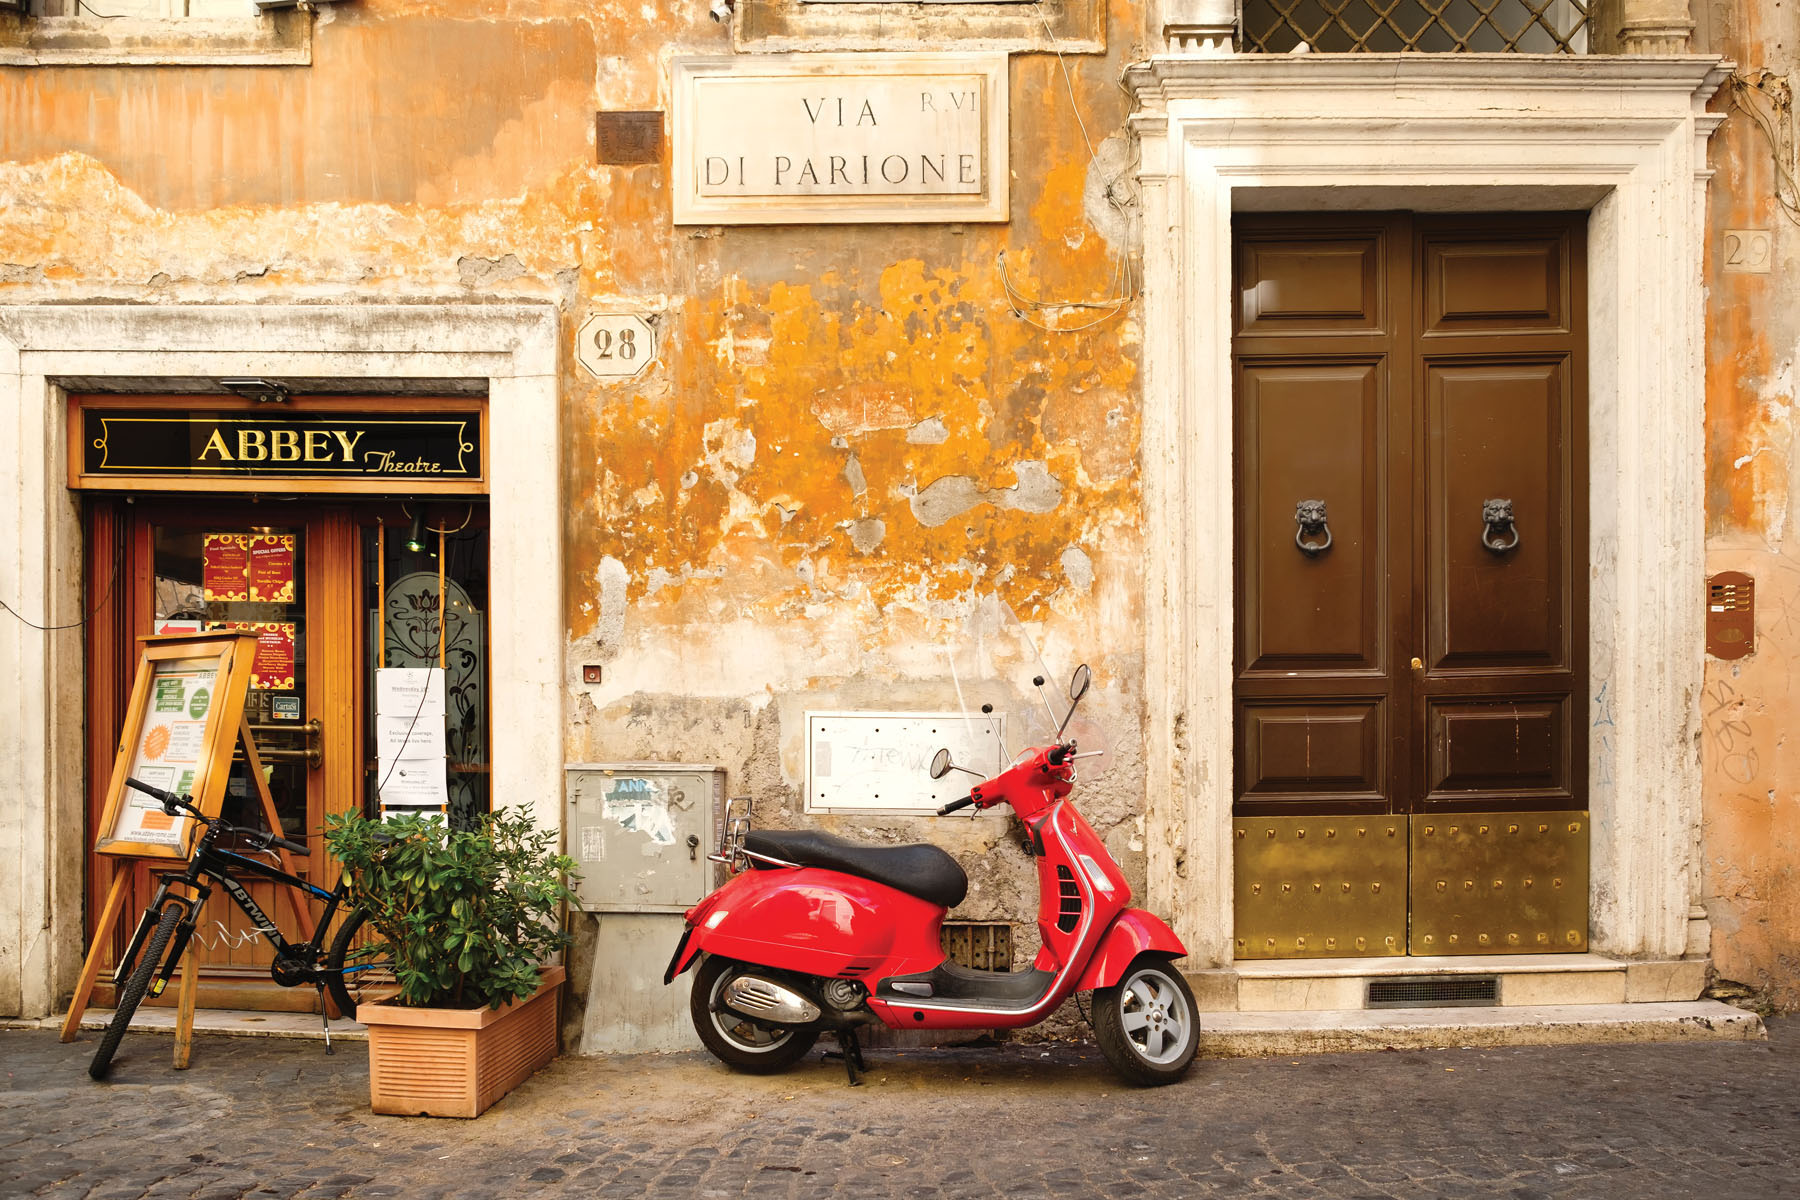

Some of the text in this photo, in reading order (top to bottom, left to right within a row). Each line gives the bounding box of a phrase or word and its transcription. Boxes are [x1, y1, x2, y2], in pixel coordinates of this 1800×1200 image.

[802, 97, 878, 127] VIA
[705, 154, 976, 186] DI PARIONE
[1725, 234, 1769, 267] 29
[593, 328, 637, 360] 28
[197, 428, 442, 473] ABBEY Theatre
